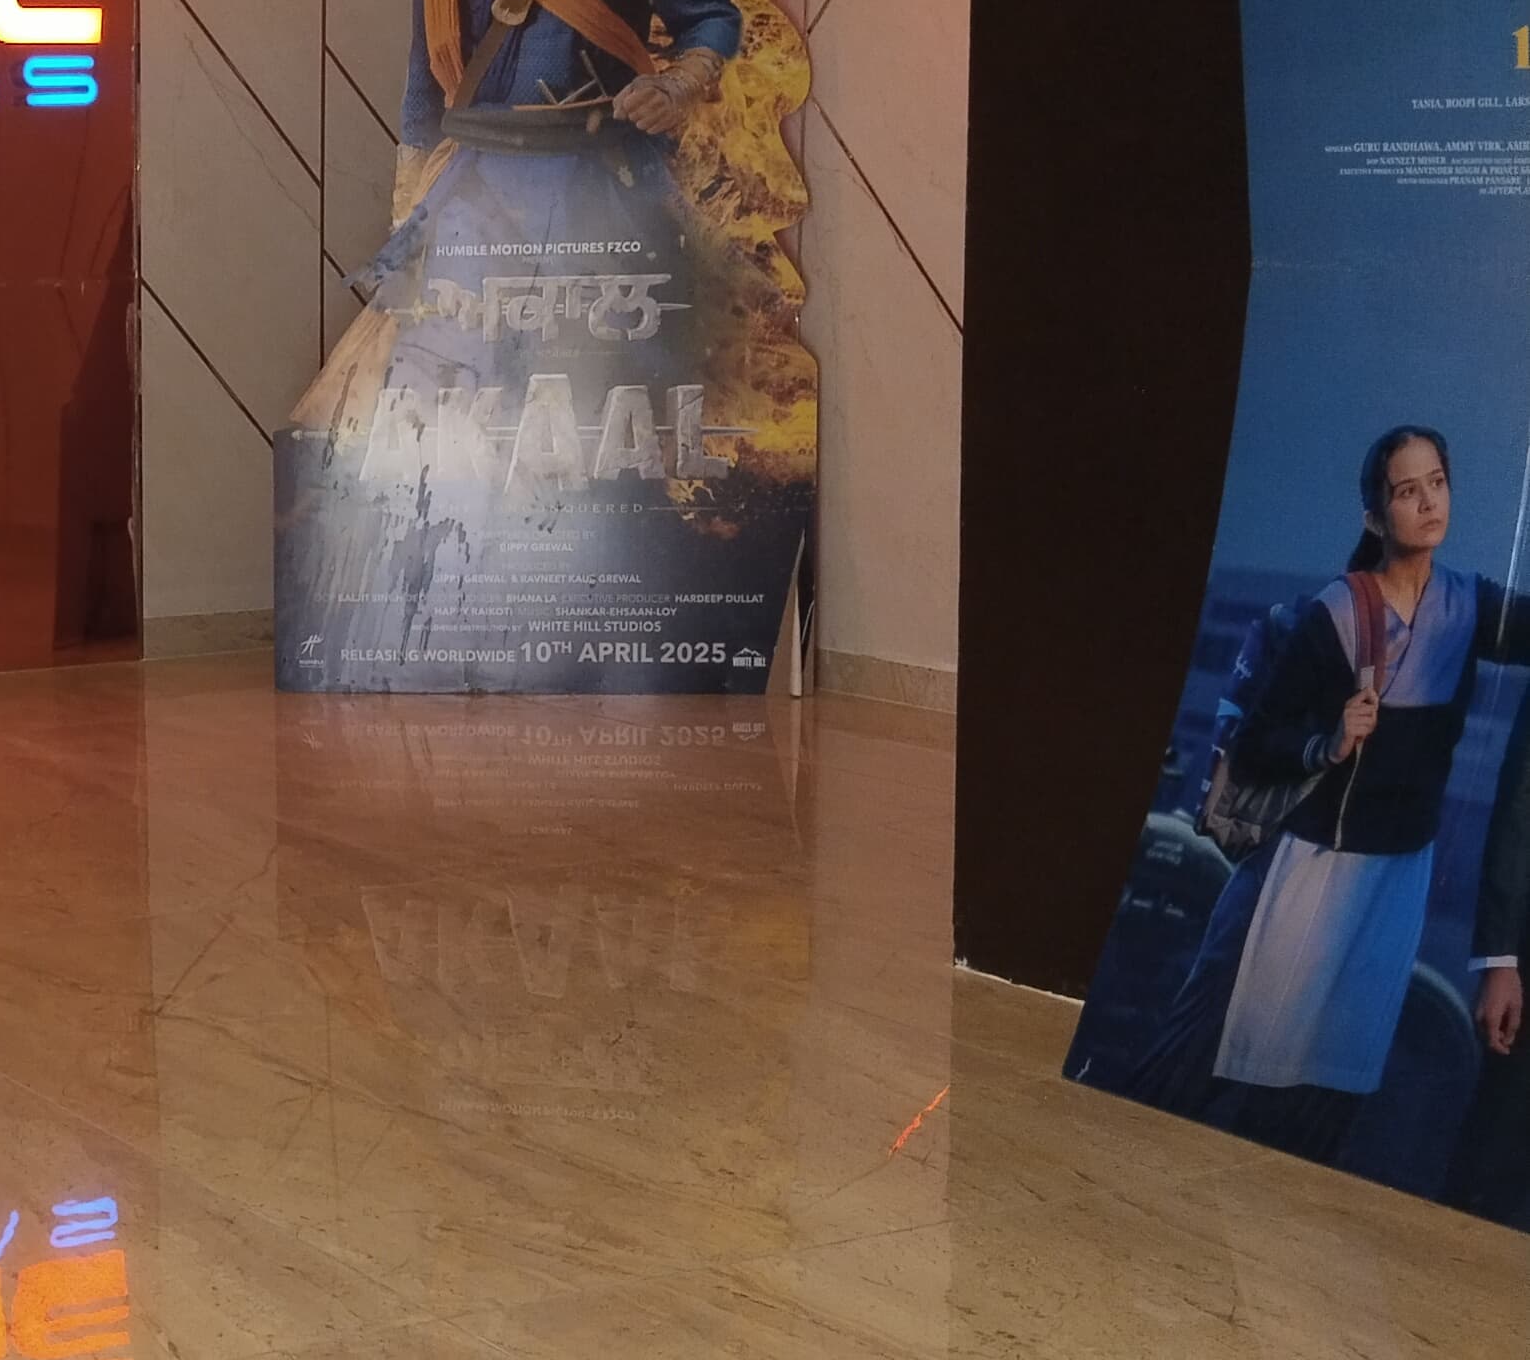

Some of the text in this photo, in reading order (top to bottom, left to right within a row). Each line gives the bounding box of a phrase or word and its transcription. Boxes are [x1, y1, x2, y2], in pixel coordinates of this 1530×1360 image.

[1353, 142, 1381, 152] GURU
[1444, 141, 1474, 151] AMMY
[436, 241, 641, 257] HUMBLE MOTION PICTURES FZCO
[358, 373, 730, 496] AKAAL
[530, 542, 574, 552] GREWAL
[464, 574, 506, 584] GREWAL
[520, 574, 566, 584] RAVNEET
[597, 573, 642, 584] GREWAL
[674, 593, 723, 603] HARDEEP
[725, 593, 765, 603] DULLAT
[470, 607, 514, 617] RAIKOTI
[555, 606, 677, 617] SHANKAR-EHSAAN-LOY
[527, 620, 570, 633] WHITE
[573, 620, 601, 632] HILL
[603, 620, 661, 633] STUDIOS
[340, 640, 726, 663] RELEASIG WORLDWIDE 10TH APRIL 2025
